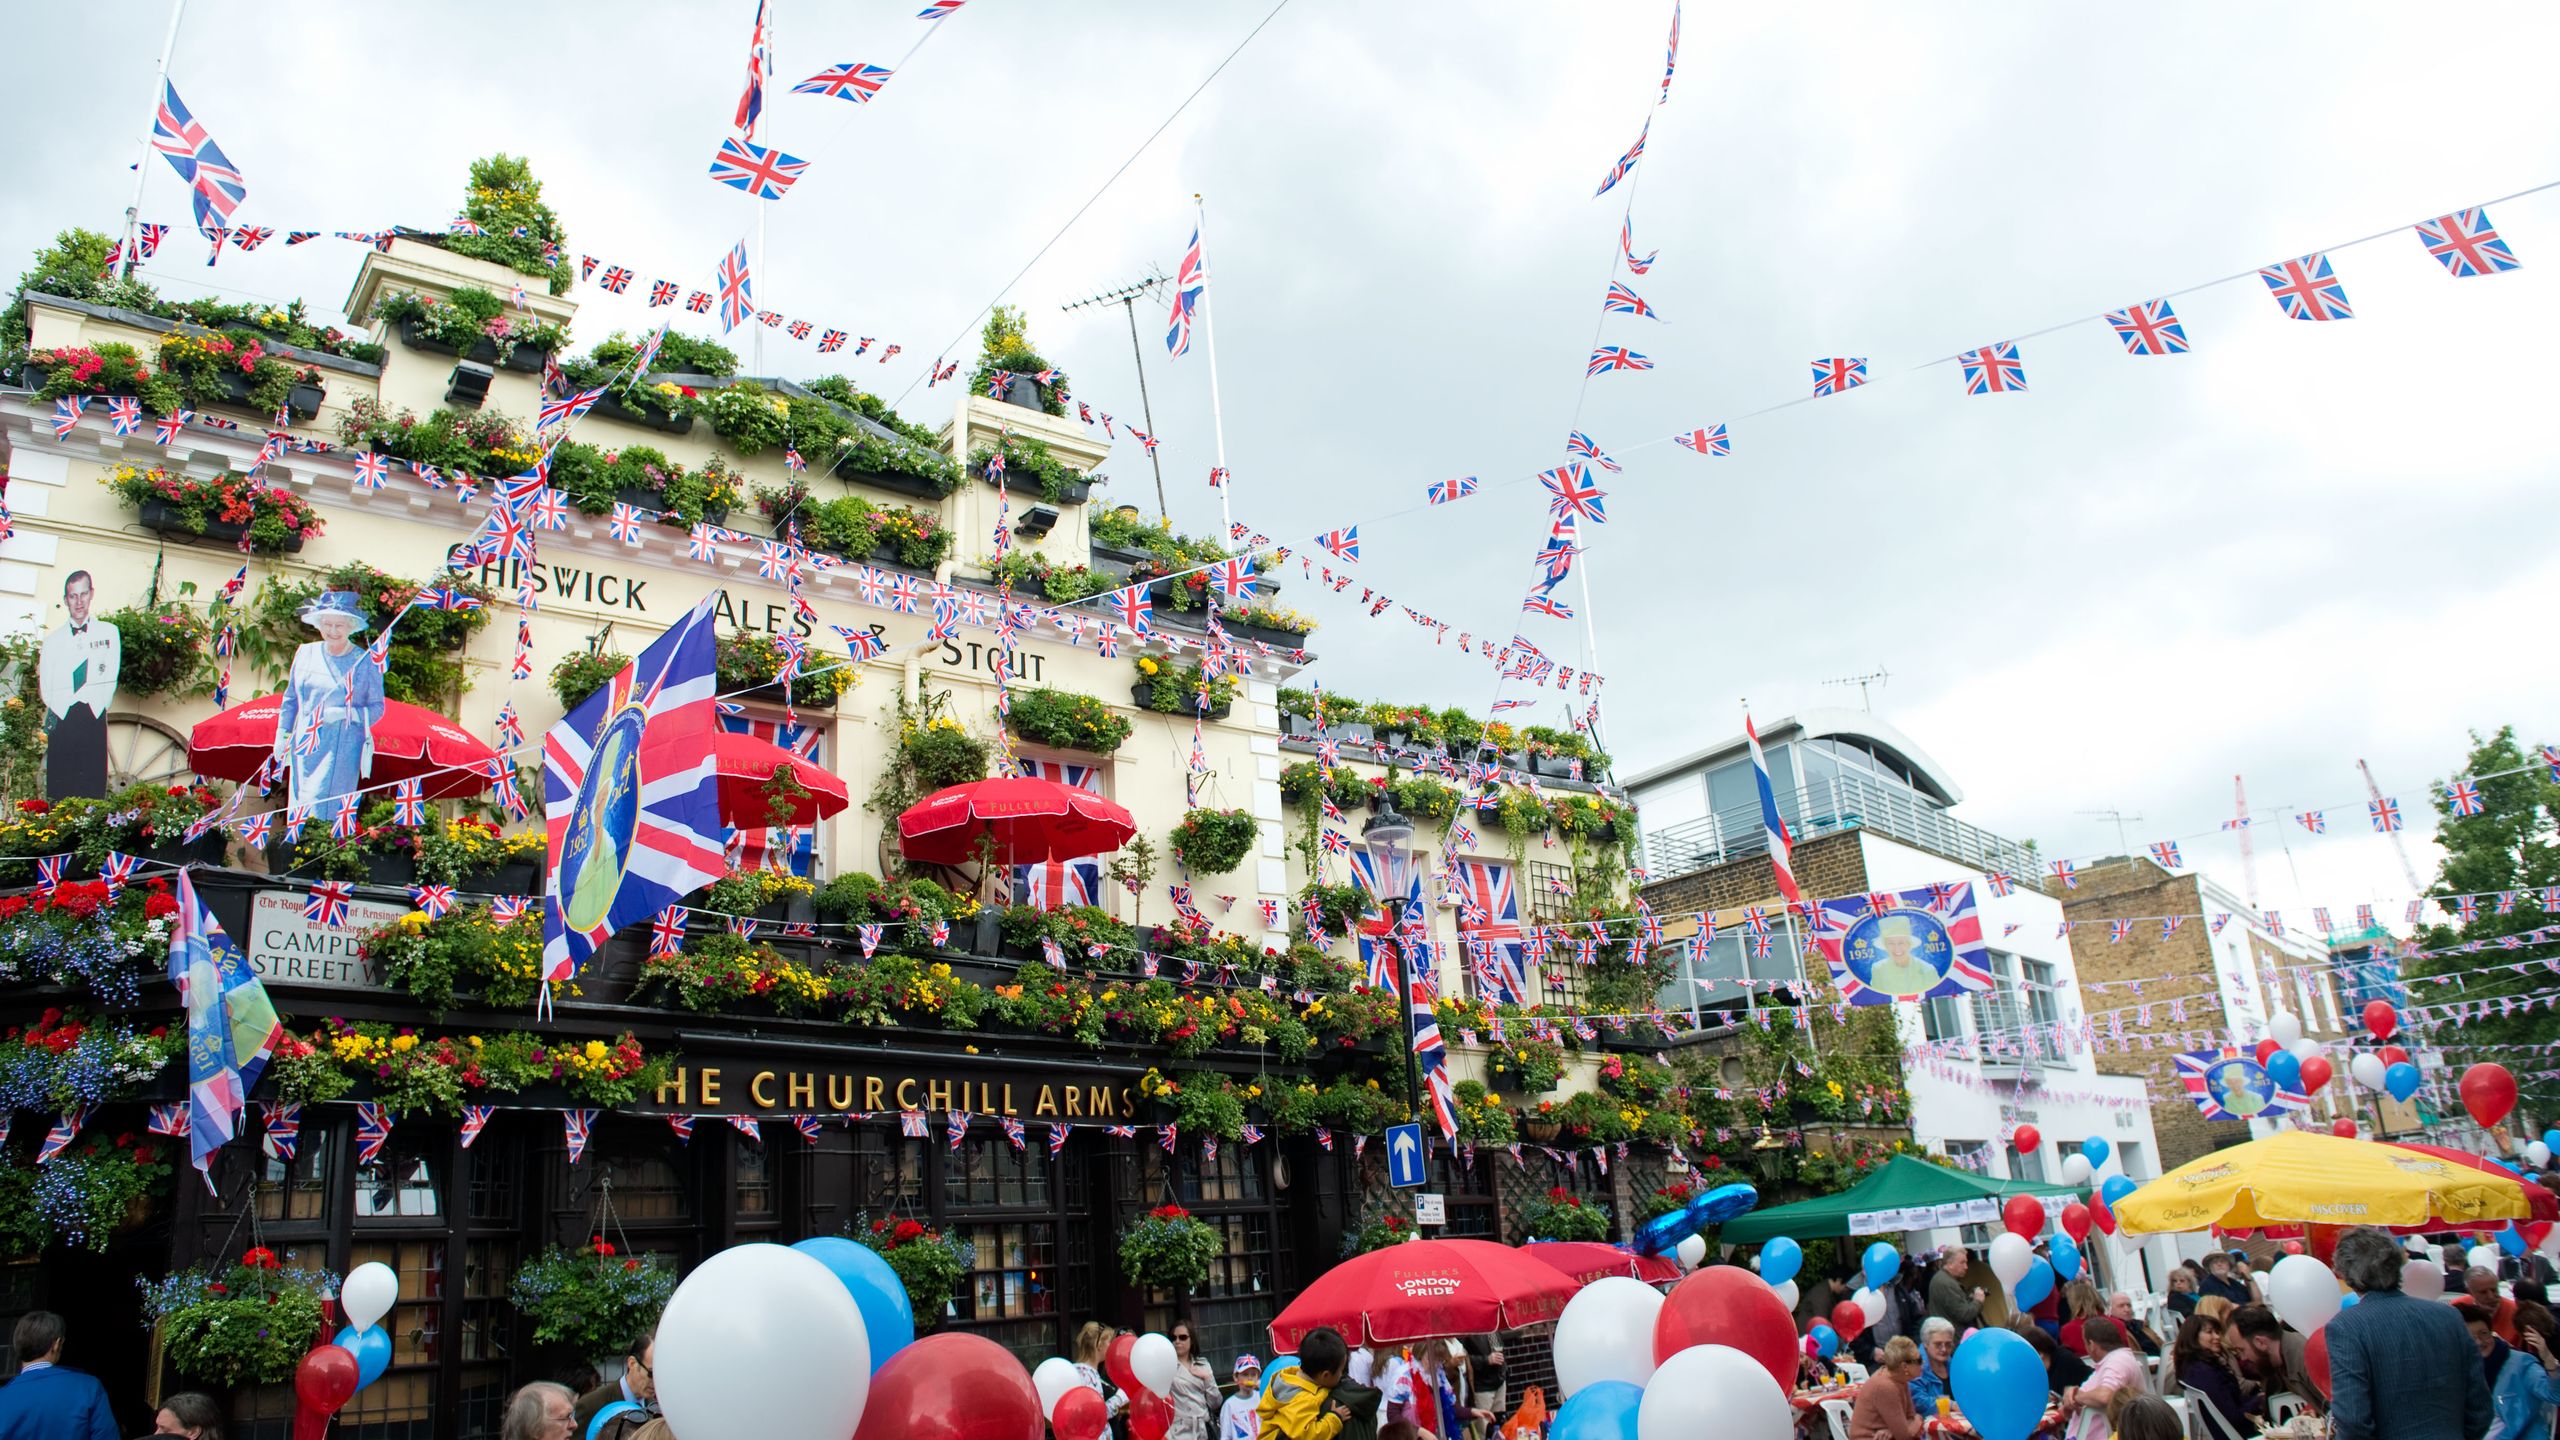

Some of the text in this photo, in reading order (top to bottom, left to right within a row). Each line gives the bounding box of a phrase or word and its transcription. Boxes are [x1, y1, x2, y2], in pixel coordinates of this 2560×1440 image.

[447, 543, 648, 611] CHISWICK
[714, 590, 812, 638] ALES
[942, 638, 1046, 682] STOUT
[259, 896, 278, 909] The
[350, 907, 360, 917] of
[307, 921, 323, 931] and
[1849, 941, 1947, 960] 1952 2012
[253, 954, 356, 983] STREET,
[656, 1067, 1135, 1119] HE CHURCHILL ARMS
[2310, 1203, 2368, 1215] DISCOVERY
[1394, 1268, 1460, 1279] FULLER'S
[1396, 1277, 1461, 1290] LONDON
[1407, 1286, 1455, 1297] PRIDE
